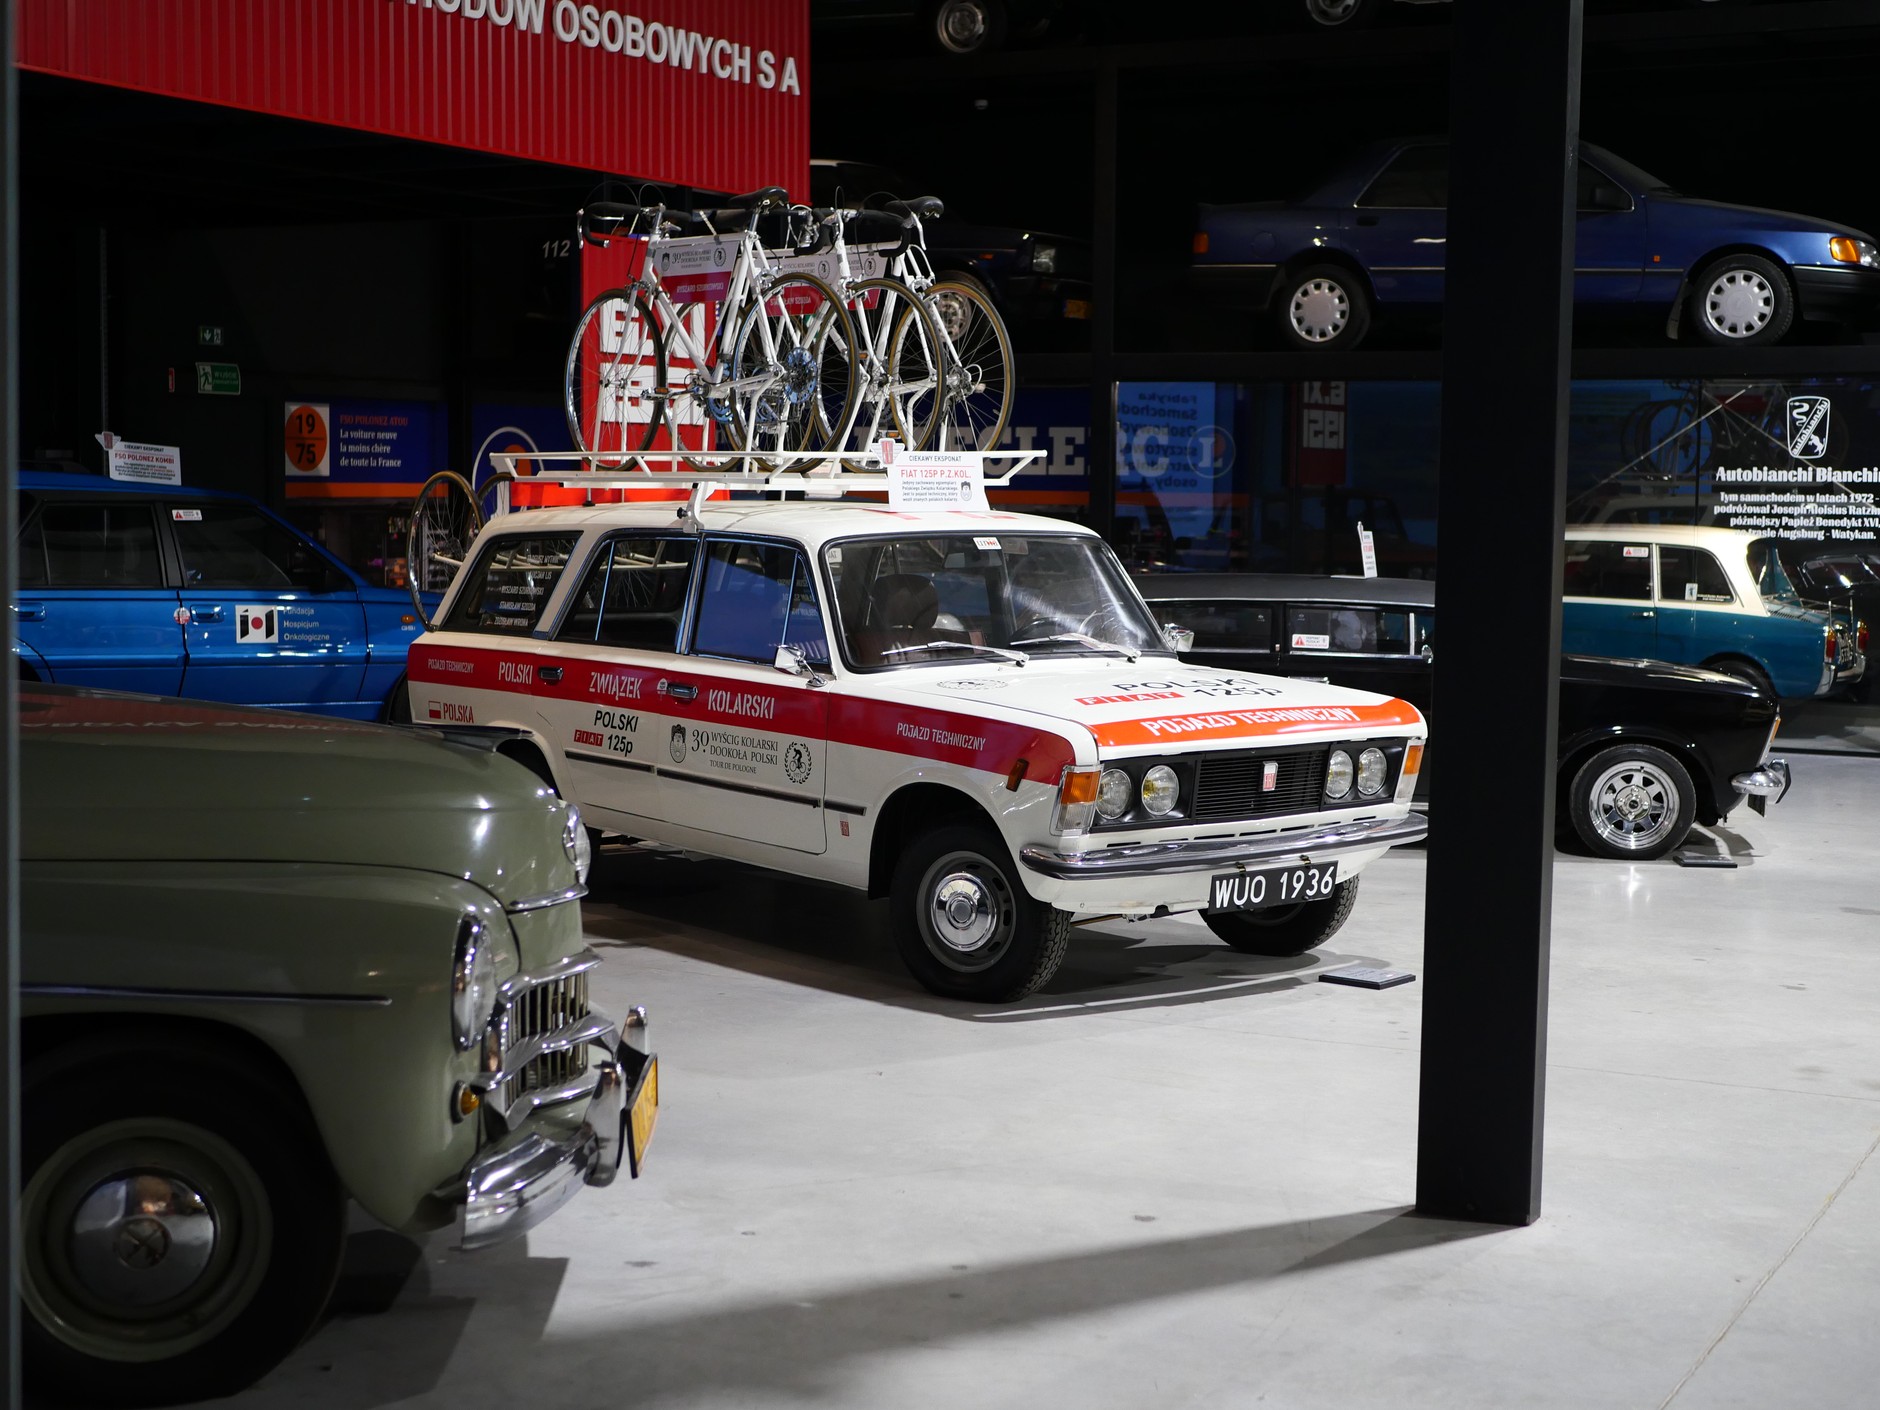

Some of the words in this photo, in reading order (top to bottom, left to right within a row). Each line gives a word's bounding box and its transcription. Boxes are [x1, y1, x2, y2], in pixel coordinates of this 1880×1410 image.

[553, 0, 751, 84] OSOBOWYCH
[757, 50, 776, 89] S
[780, 56, 800, 96] A
[542, 240, 571, 258] 112
[296, 413, 316, 434] 19
[355, 415, 388, 426] POLONEZ
[340, 429, 349, 439] La
[350, 429, 376, 440] voiture
[377, 431, 398, 440] neuve
[296, 443, 316, 464] 75
[340, 442, 347, 452] la
[348, 442, 370, 453] moins
[371, 443, 391, 453] chère
[128, 454, 154, 462] POLONEZ
[156, 457, 175, 465] KOMBI
[340, 456, 349, 466] de
[350, 458, 369, 467] toute
[370, 457, 377, 467] la
[378, 457, 402, 468] France
[901, 470, 917, 478] FIAT
[920, 470, 938, 478] 125P
[940, 470, 972, 479] P.Z.KOL.
[1715, 466, 1813, 482] Autobianchi
[1816, 466, 1880, 482] Bianchi
[1720, 491, 1739, 503] Tym
[1740, 491, 1805, 503] samochodem
[1806, 494, 1815, 503] w
[1816, 493, 1848, 503] latach
[1849, 493, 1874, 503] 1972
[1714, 503, 1770, 515] podróżował
[1771, 504, 1807, 516] Joseph
[1730, 515, 1780, 528] późniejszy
[1782, 516, 1815, 528] Papież
[1816, 517, 1862, 528] Benedykt
[1748, 527, 1777, 538] trasie
[1778, 528, 1825, 540] Augsburg
[1831, 529, 1877, 540] Watykan.
[283, 607, 314, 618] Fundacja
[283, 620, 320, 630] Hospicjum
[284, 633, 330, 643] Onkologiczne
[427, 658, 446, 670] POJAZD
[446, 660, 475, 673] TECHNICZNY
[498, 661, 533, 684] POLSKI
[589, 671, 643, 701] ZWIĄZEK
[708, 689, 775, 719] KOLARSKI
[1113, 678, 1260, 691] POLSKI
[1079, 692, 1184, 706] FIAT
[1193, 686, 1283, 697] 125p
[443, 702, 474, 723] POLSKA
[594, 710, 639, 732] POLSKI
[1141, 713, 1239, 736] POJAZD
[1232, 708, 1361, 724] TECHNICZNY
[575, 731, 603, 745] FIAT
[607, 734, 633, 757] 125p
[691, 729, 709, 753] 30.
[711, 731, 739, 746] WYŚCIG
[741, 736, 778, 751] KOLARSKI
[896, 722, 930, 741] POJAZD
[932, 729, 986, 751] TECHNICZNY
[710, 745, 748, 760] DOOKOŁA
[751, 751, 778, 766] POLSKI
[710, 759, 724, 768] TOUR
[732, 763, 757, 774] POLOGNE
[1215, 875, 1266, 909] WUO
[1280, 866, 1334, 900] 1936
